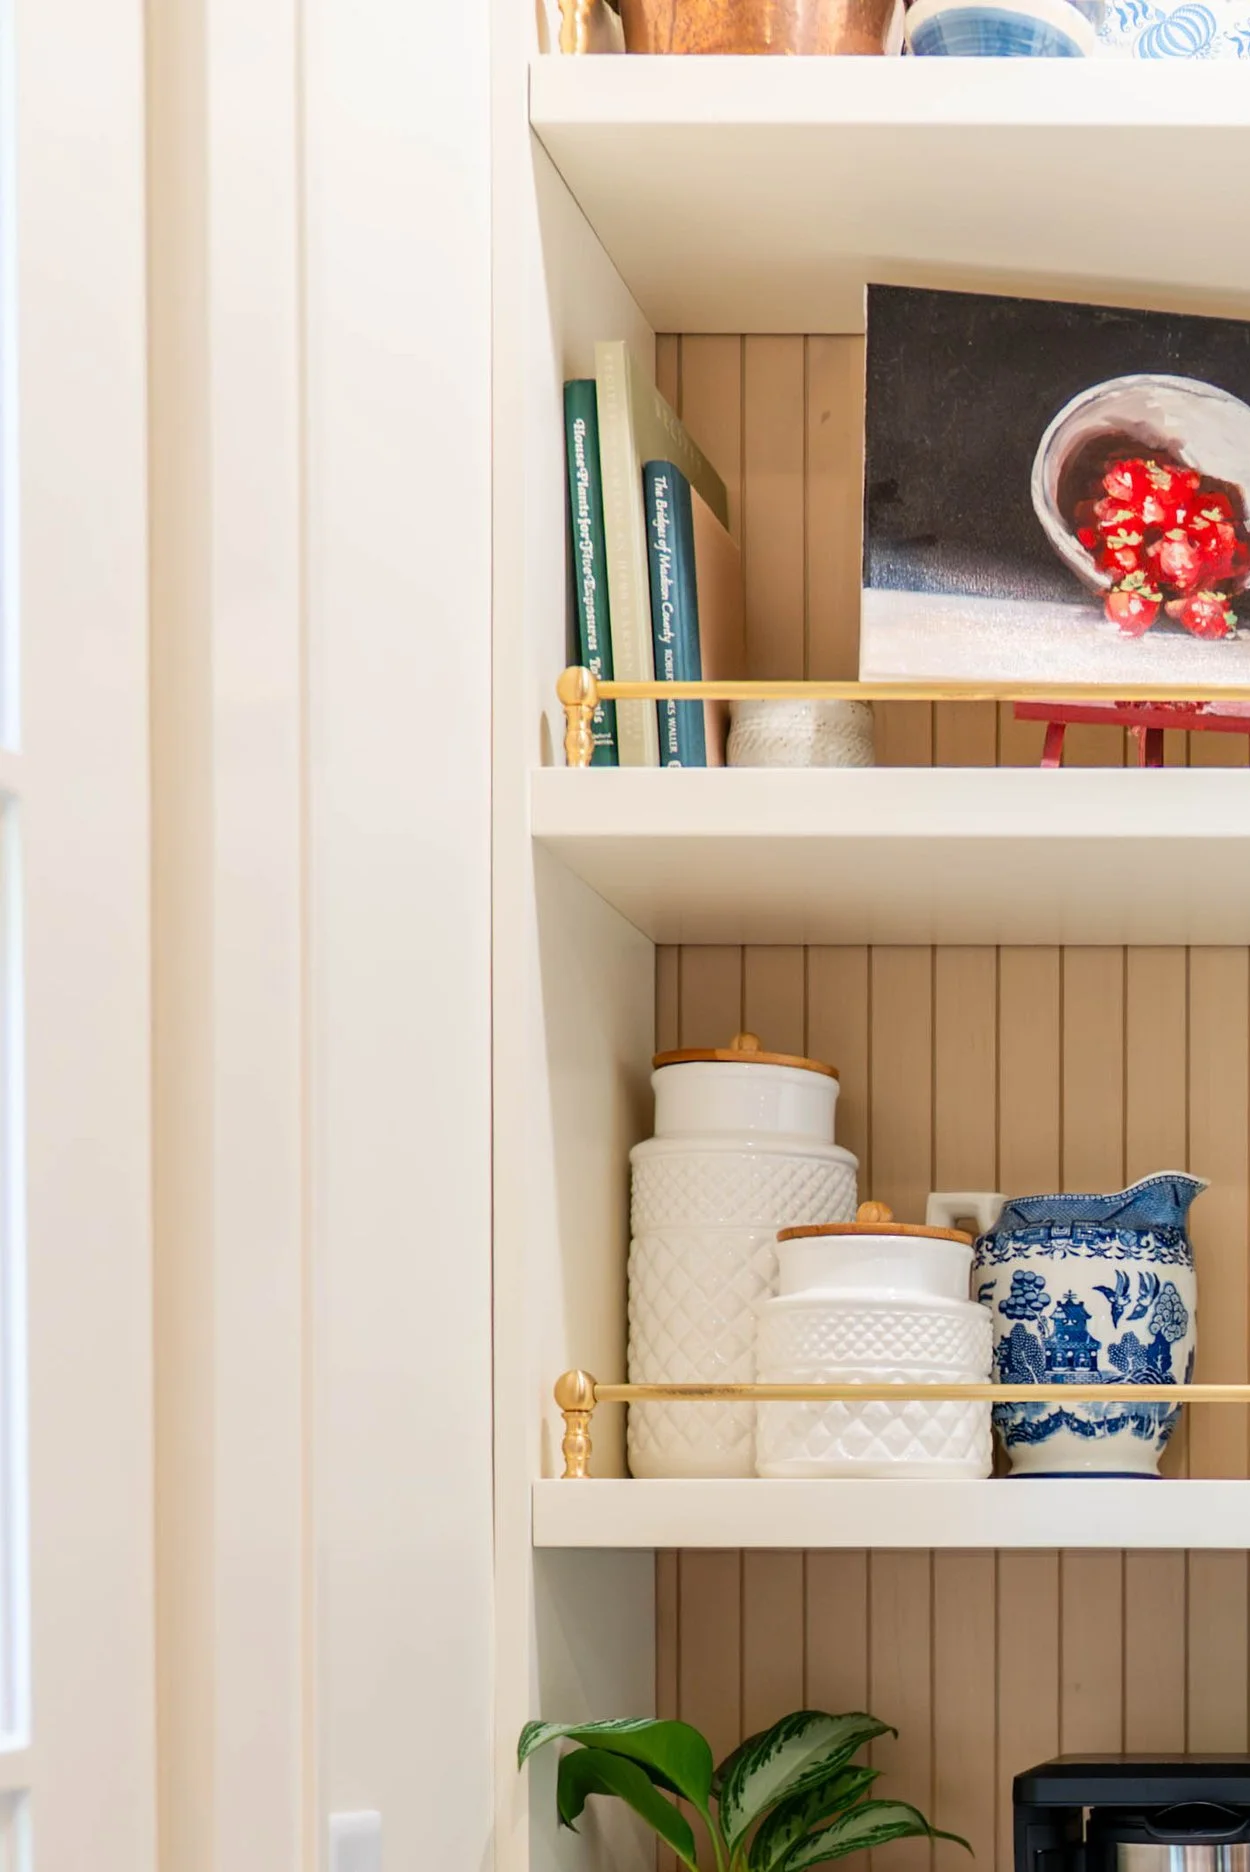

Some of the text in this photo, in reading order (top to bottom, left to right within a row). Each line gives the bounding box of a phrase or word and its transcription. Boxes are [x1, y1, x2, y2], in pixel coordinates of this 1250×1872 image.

[573, 417, 586, 468] House
[576, 467, 590, 518] Plants
[653, 475, 668, 498] The
[577, 517, 591, 540] for
[652, 498, 670, 538] Bridges
[579, 538, 594, 576] Five
[654, 537, 672, 554] of
[658, 552, 674, 600] Madison
[583, 576, 598, 651] Exposures
[657, 601, 675, 644] County
[668, 717, 678, 754] WALLER
